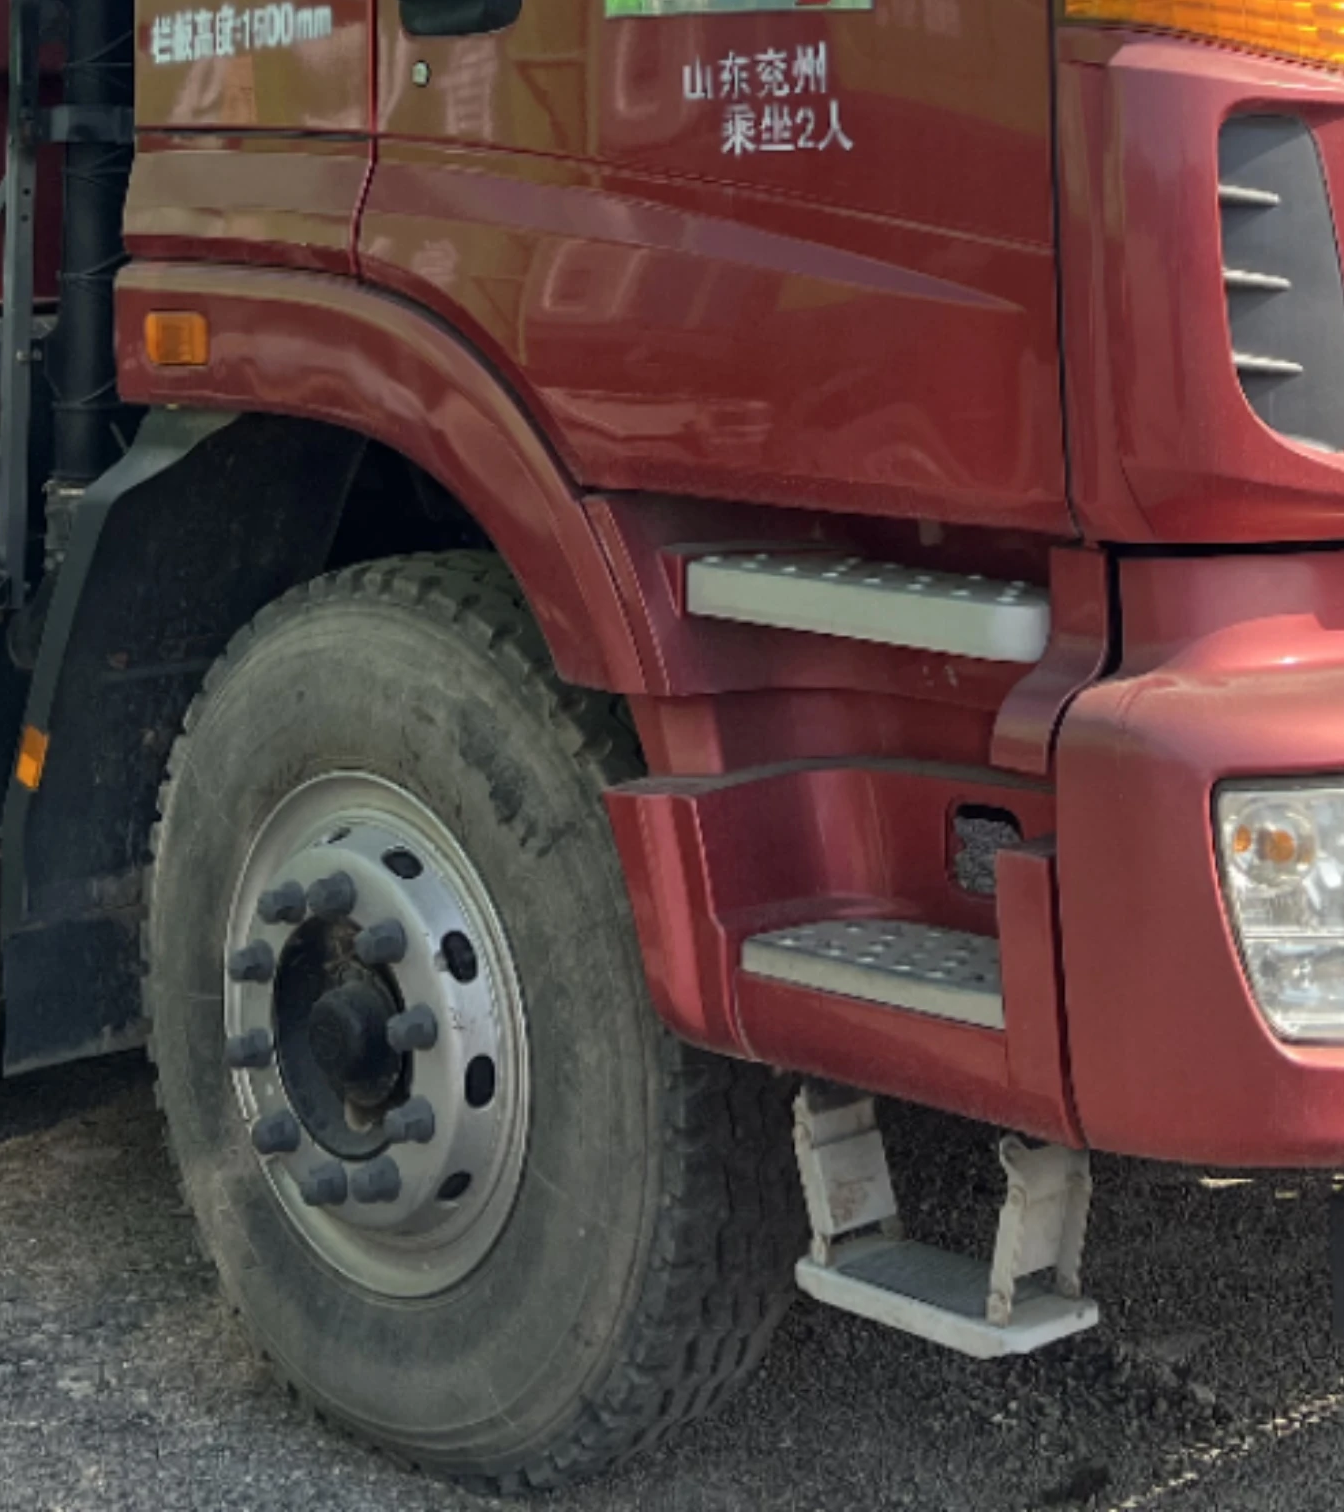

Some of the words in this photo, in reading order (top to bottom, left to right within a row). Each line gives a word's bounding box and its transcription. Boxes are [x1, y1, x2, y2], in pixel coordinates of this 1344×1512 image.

[682, 40, 826, 100] 山东兖州
[721, 99, 853, 157] 乘坐2人
